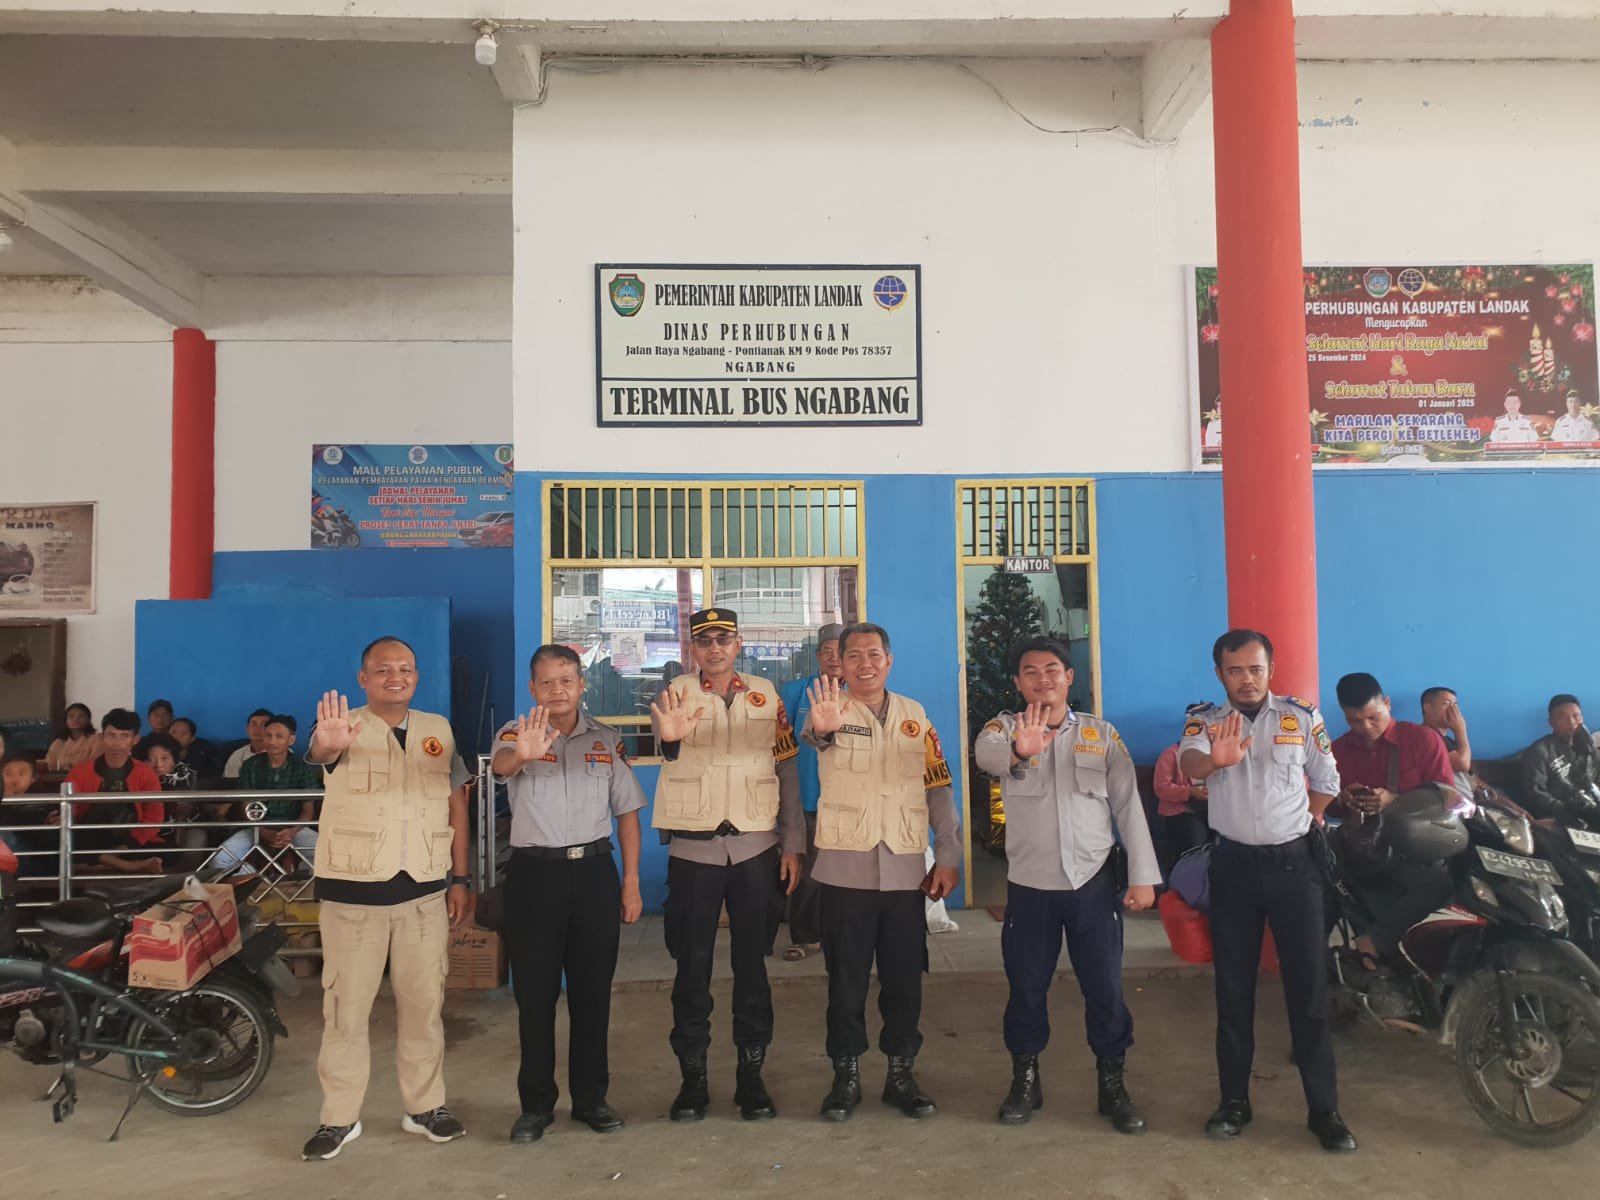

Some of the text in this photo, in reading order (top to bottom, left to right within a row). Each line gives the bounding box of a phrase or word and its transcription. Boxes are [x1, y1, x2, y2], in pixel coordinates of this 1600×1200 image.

[655, 284, 863, 307] PEMERINTAH KABUPATEN LANDAK
[1305, 299, 1530, 315] PERHUBUNGAN KABUPATEN LANDAK
[1365, 317, 1428, 330] Mengucapkan
[664, 323, 850, 341] DINAS PERHUBUNGAN
[1306, 332, 1489, 355] Selamat Hari Raya Natal
[626, 346, 652, 356] Jalan
[655, 346, 680, 357] Raya
[682, 346, 725, 357] Ngabang
[735, 345, 786, 356] Pontianak
[788, 346, 803, 356] KM
[805, 346, 812, 356] 9
[815, 345, 839, 356] Kode
[841, 346, 859, 356] Pos
[862, 346, 892, 356] 78357
[1308, 354, 1367, 362] 25 Desember 2024
[725, 362, 796, 373] NGABANG
[1389, 356, 1408, 376] &
[1324, 380, 1476, 399] Selamat Tahun Baru
[610, 386, 910, 416] TERMINAL BUS NGABANG
[1418, 400, 1475, 409] 01 Januari 2025
[1335, 414, 1464, 427] MARILAH SEKARANG
[1324, 429, 1481, 443] KITA PERGI KE BETLEHEM
[353, 465, 483, 475] MALL PELAYANAN PUBLIK
[318, 476, 359, 485] PELAYANAN
[361, 476, 408, 485] PEMBAYARAN
[378, 487, 455, 496] JADWAL PELAYANAN
[368, 496, 396, 505] SETIAP
[397, 496, 418, 505] HARI
[360, 520, 391, 530] PROSES
[421, 520, 449, 530] TANPA
[1006, 559, 1050, 571] KANTOR
